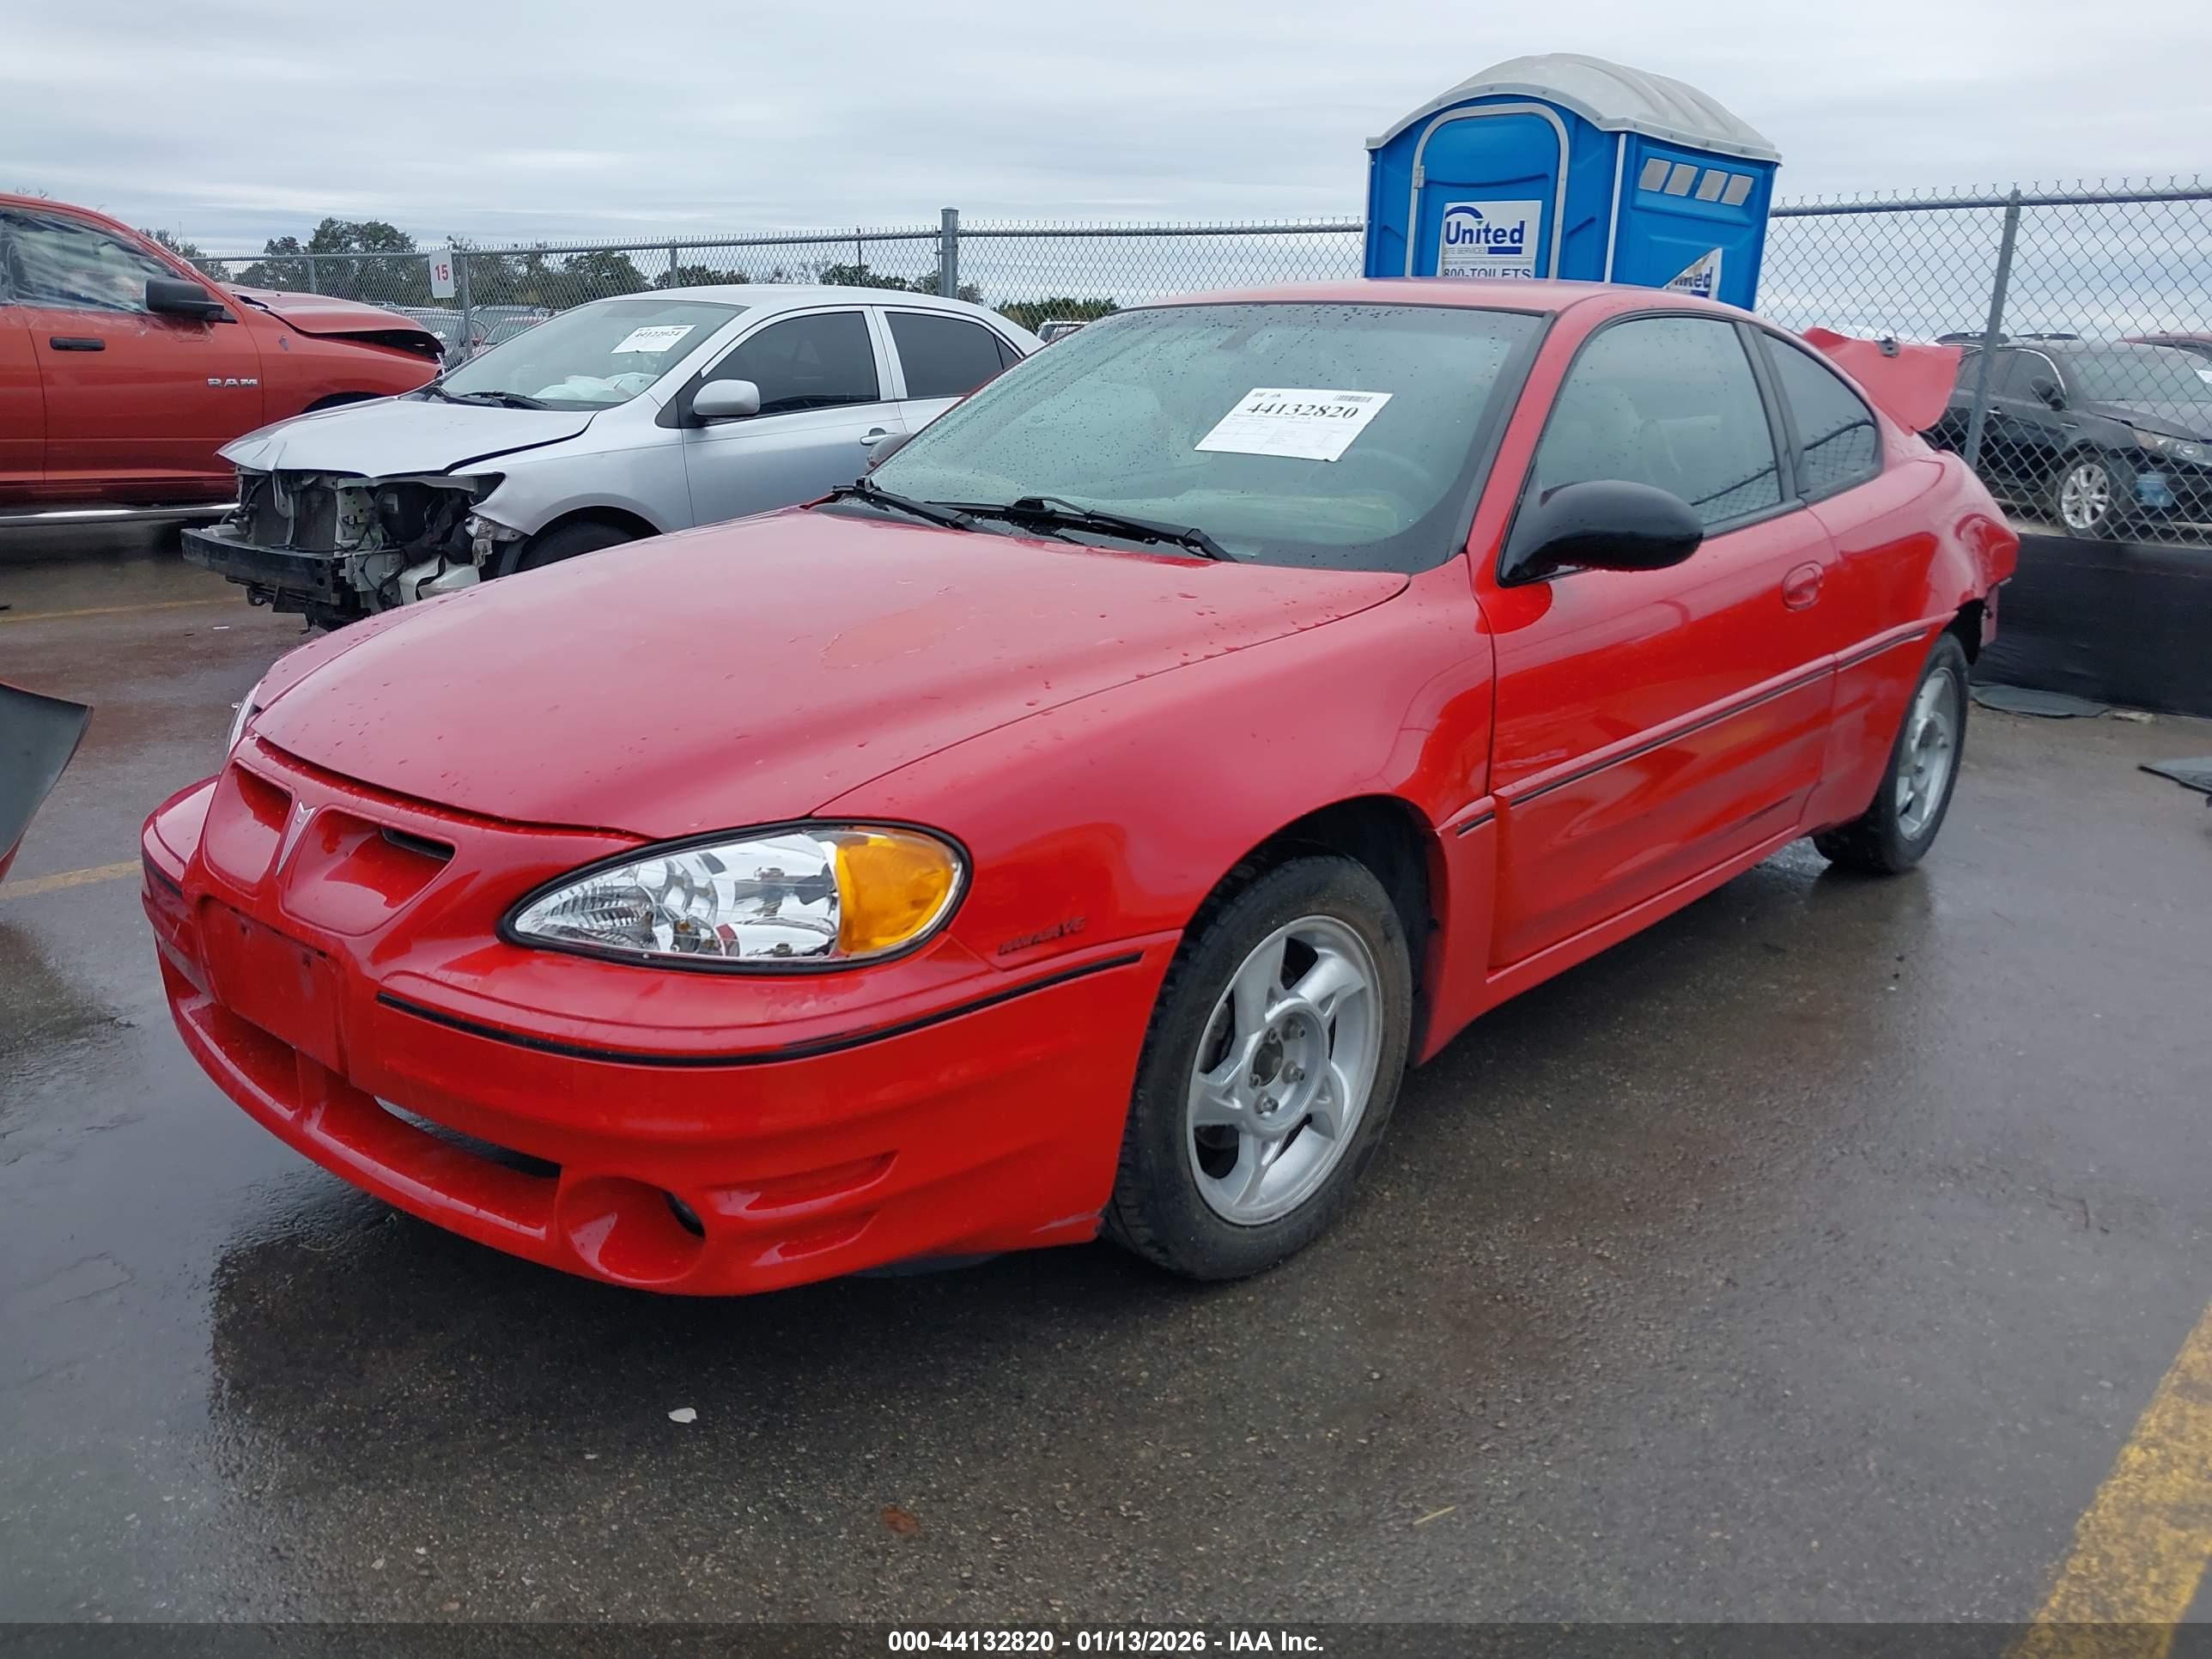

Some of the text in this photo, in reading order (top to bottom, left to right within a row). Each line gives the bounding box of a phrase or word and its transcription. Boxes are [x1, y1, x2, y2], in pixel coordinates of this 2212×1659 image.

[1445, 220, 1525, 245] United
[434, 264, 449, 281] 15
[207, 378, 260, 387] RAM
[1246, 402, 1359, 419] 44132820
